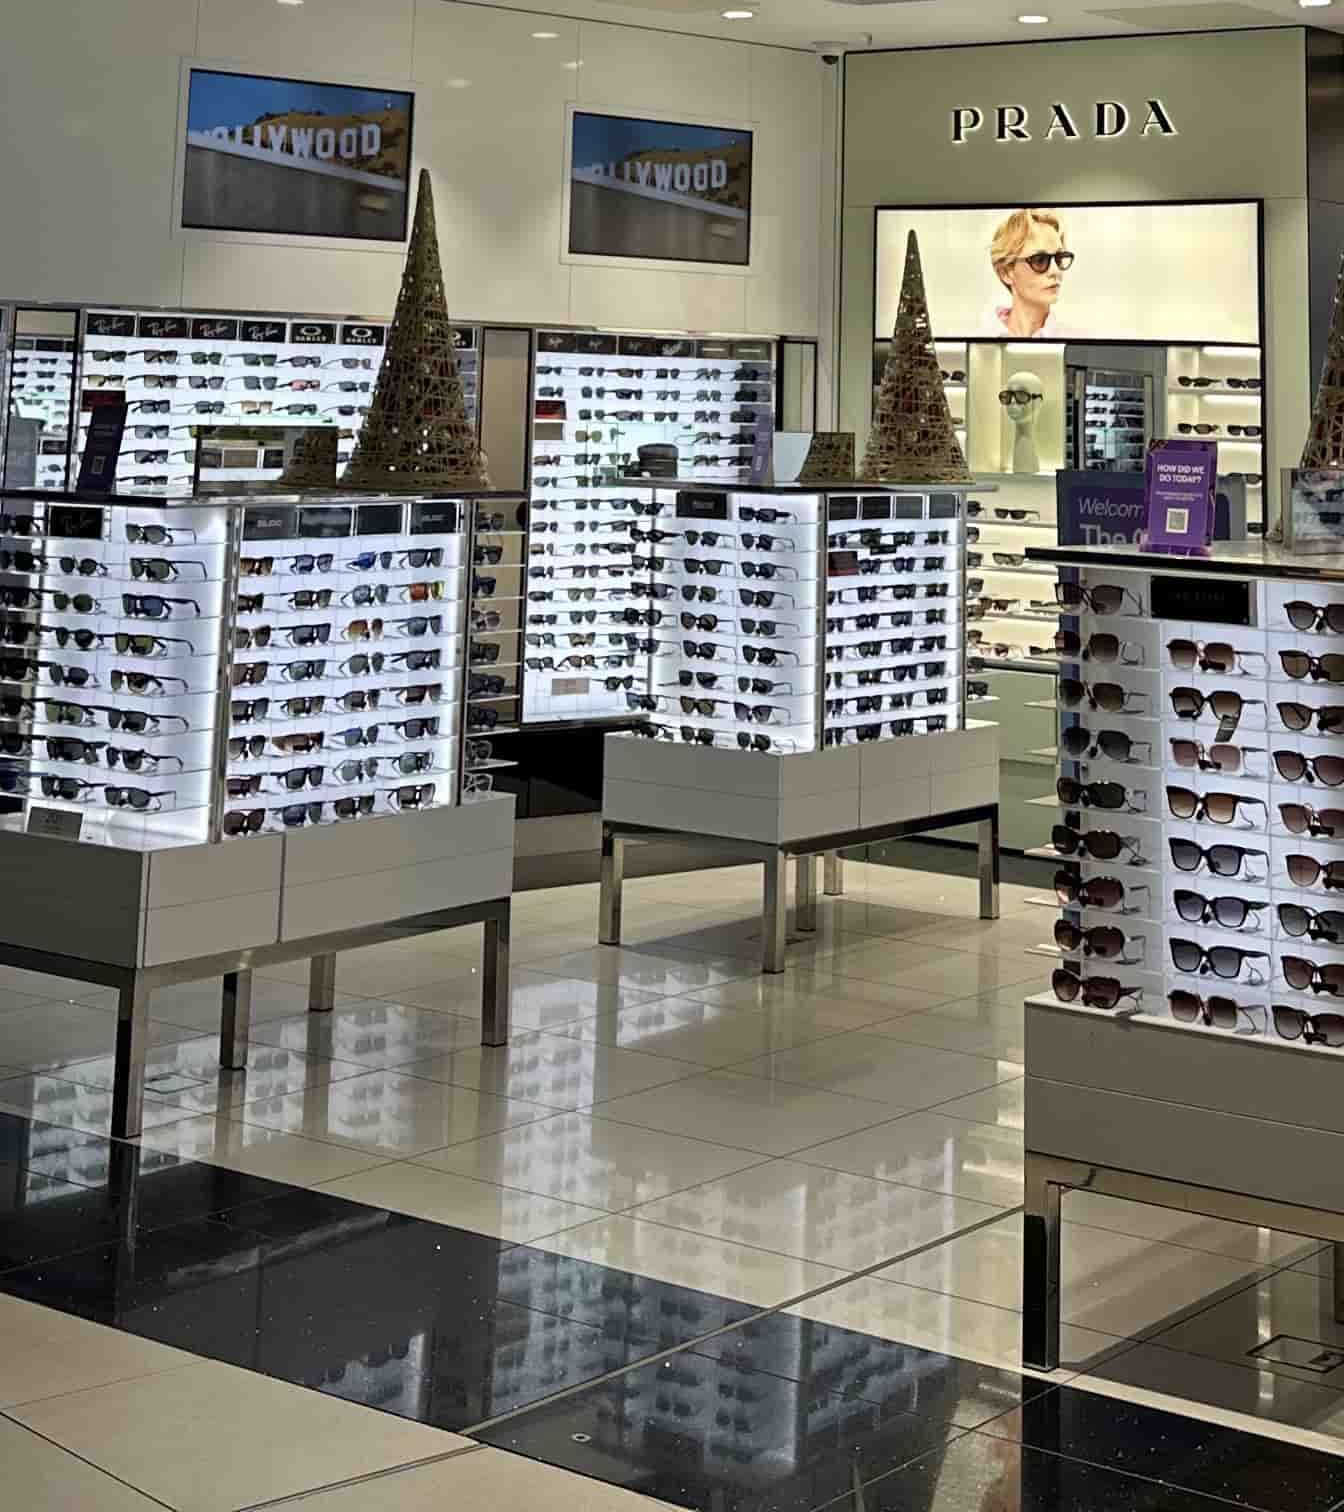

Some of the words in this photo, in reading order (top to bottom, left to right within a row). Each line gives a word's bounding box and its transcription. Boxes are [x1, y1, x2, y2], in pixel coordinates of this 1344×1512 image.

[952, 98, 1179, 144] PRADA
[1157, 463, 1177, 473] HOW
[1177, 464, 1191, 474] DID
[1191, 465, 1205, 475] WE
[1159, 474, 1172, 483] DO
